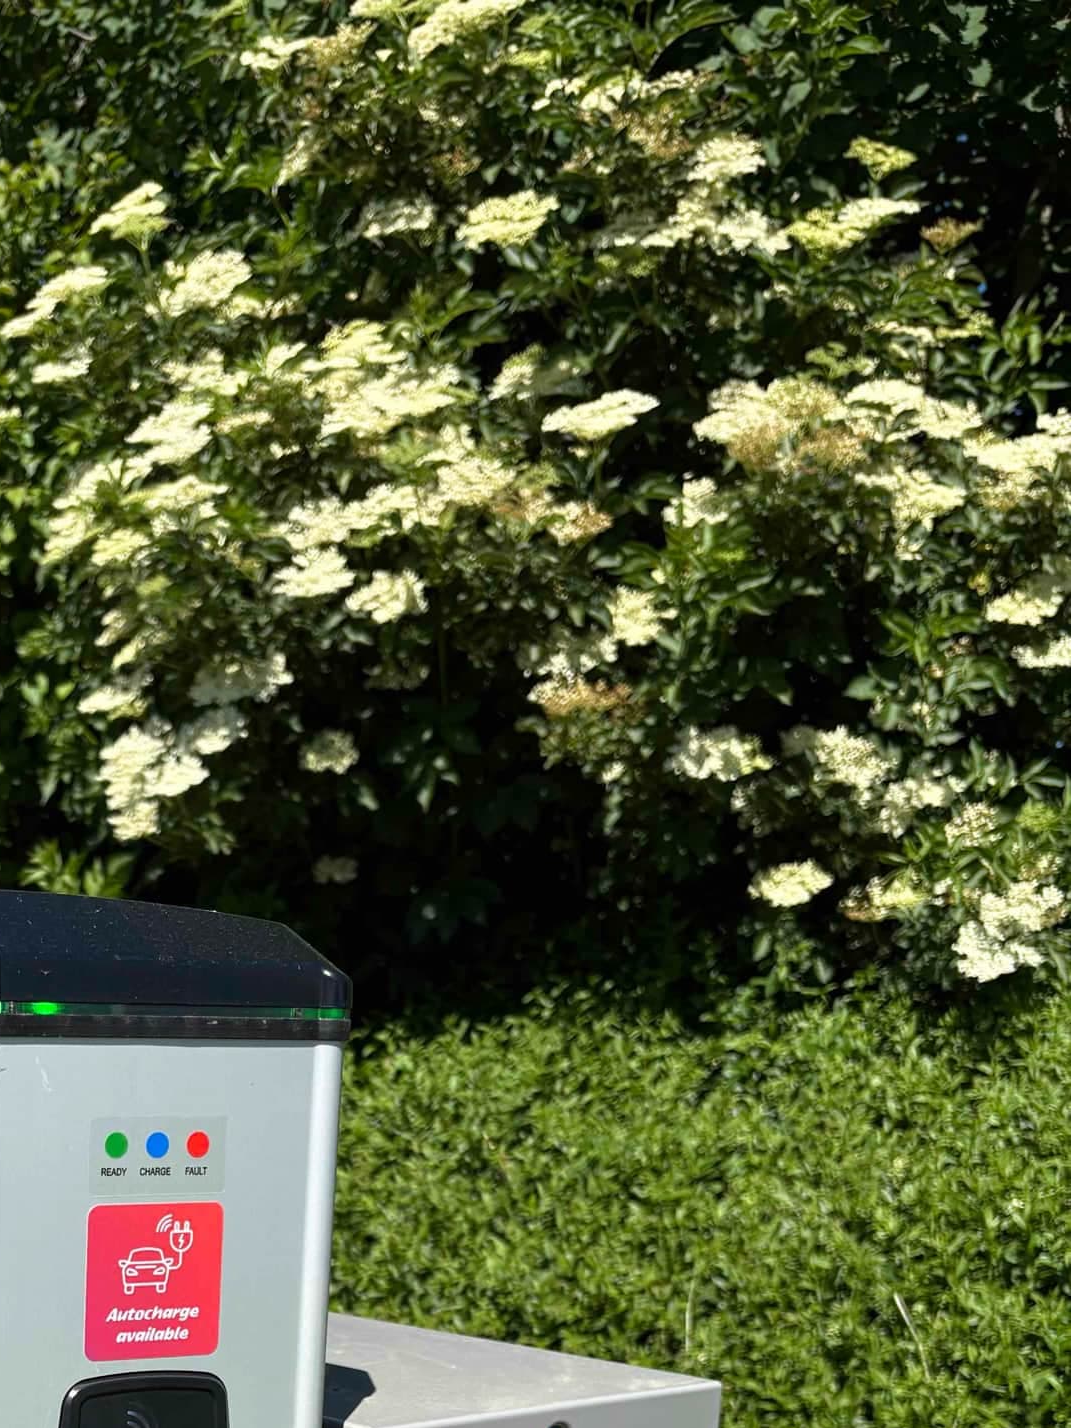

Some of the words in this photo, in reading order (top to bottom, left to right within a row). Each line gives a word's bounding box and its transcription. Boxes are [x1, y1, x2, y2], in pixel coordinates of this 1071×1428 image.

[101, 1167, 127, 1177] READY
[140, 1167, 171, 1177] CHARGE
[185, 1166, 209, 1176] FAULT
[106, 1305, 200, 1322] Autocharge
[116, 1326, 190, 1344] available
